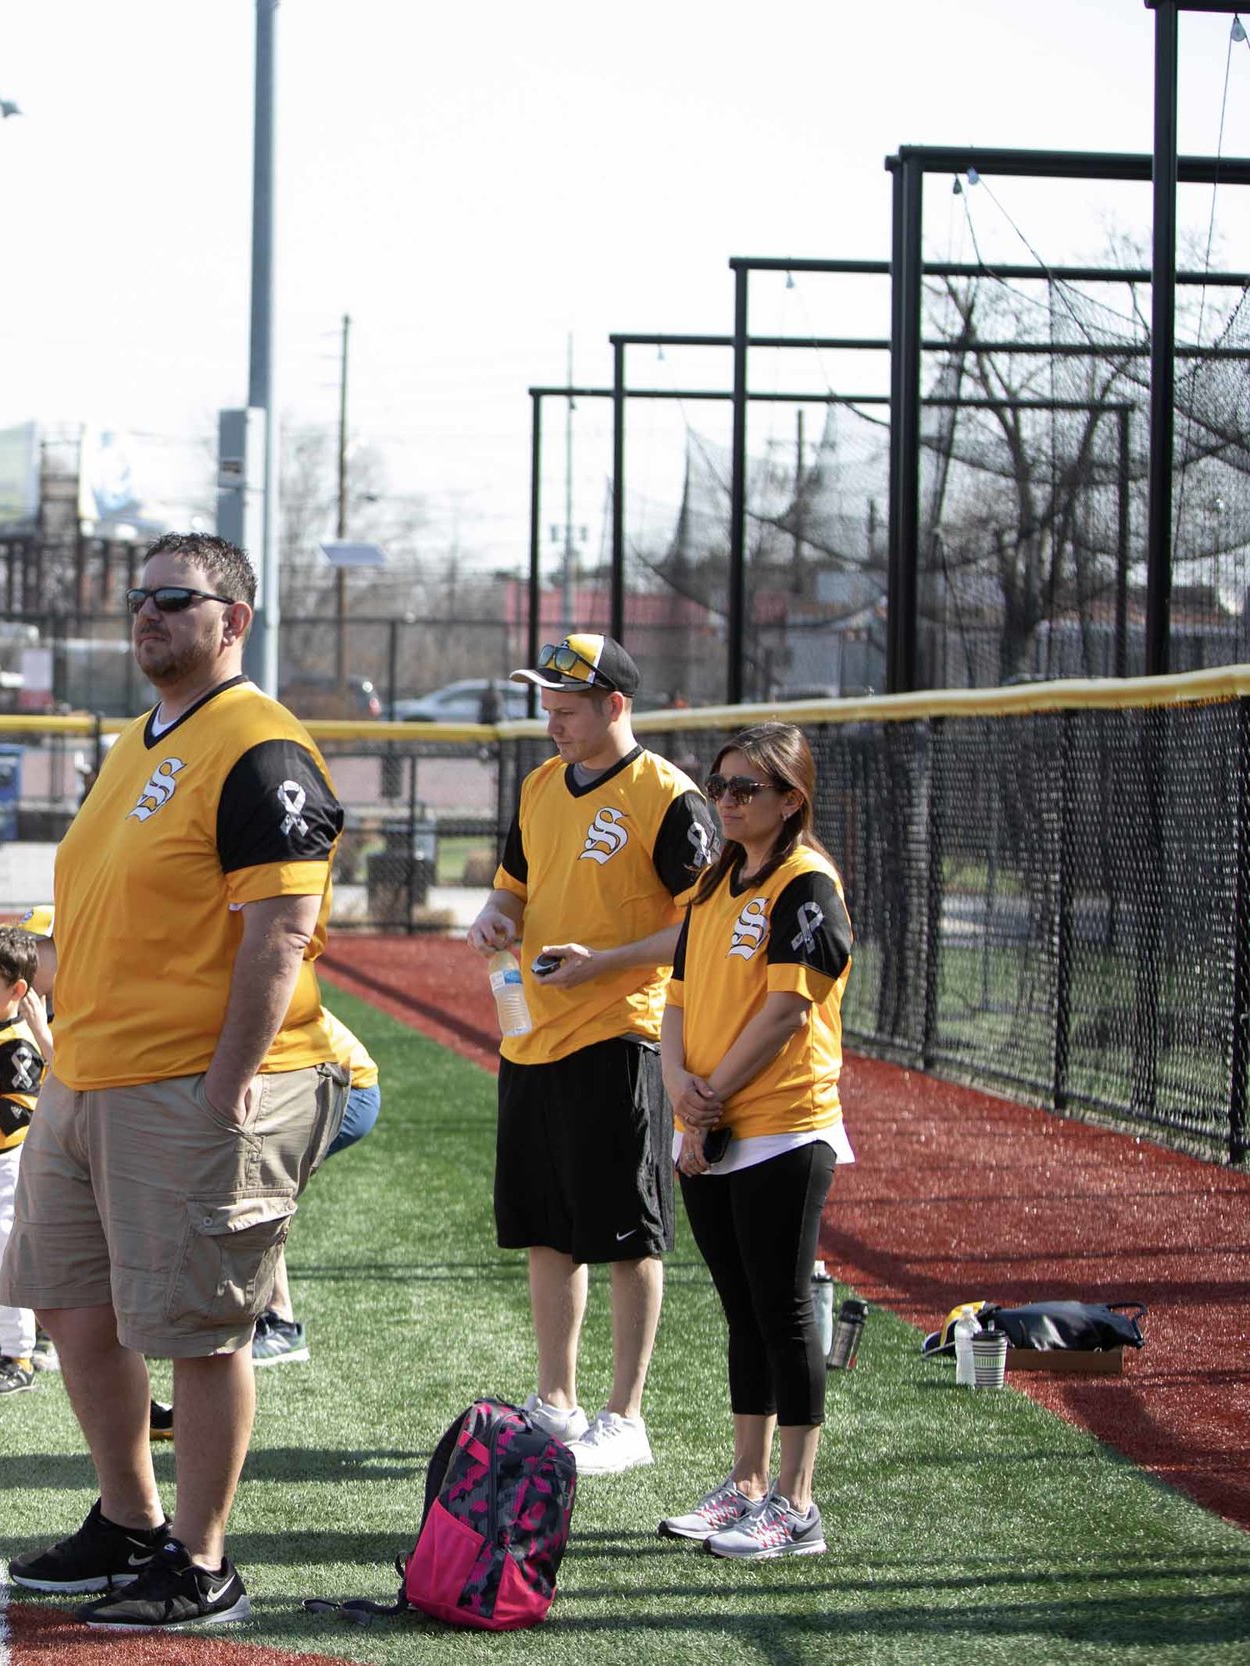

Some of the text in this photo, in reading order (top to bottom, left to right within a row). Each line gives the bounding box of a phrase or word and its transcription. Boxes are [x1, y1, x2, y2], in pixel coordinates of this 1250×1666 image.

[126, 757, 188, 823] S
[578, 806, 629, 865] S
[725, 896, 770, 960] S
